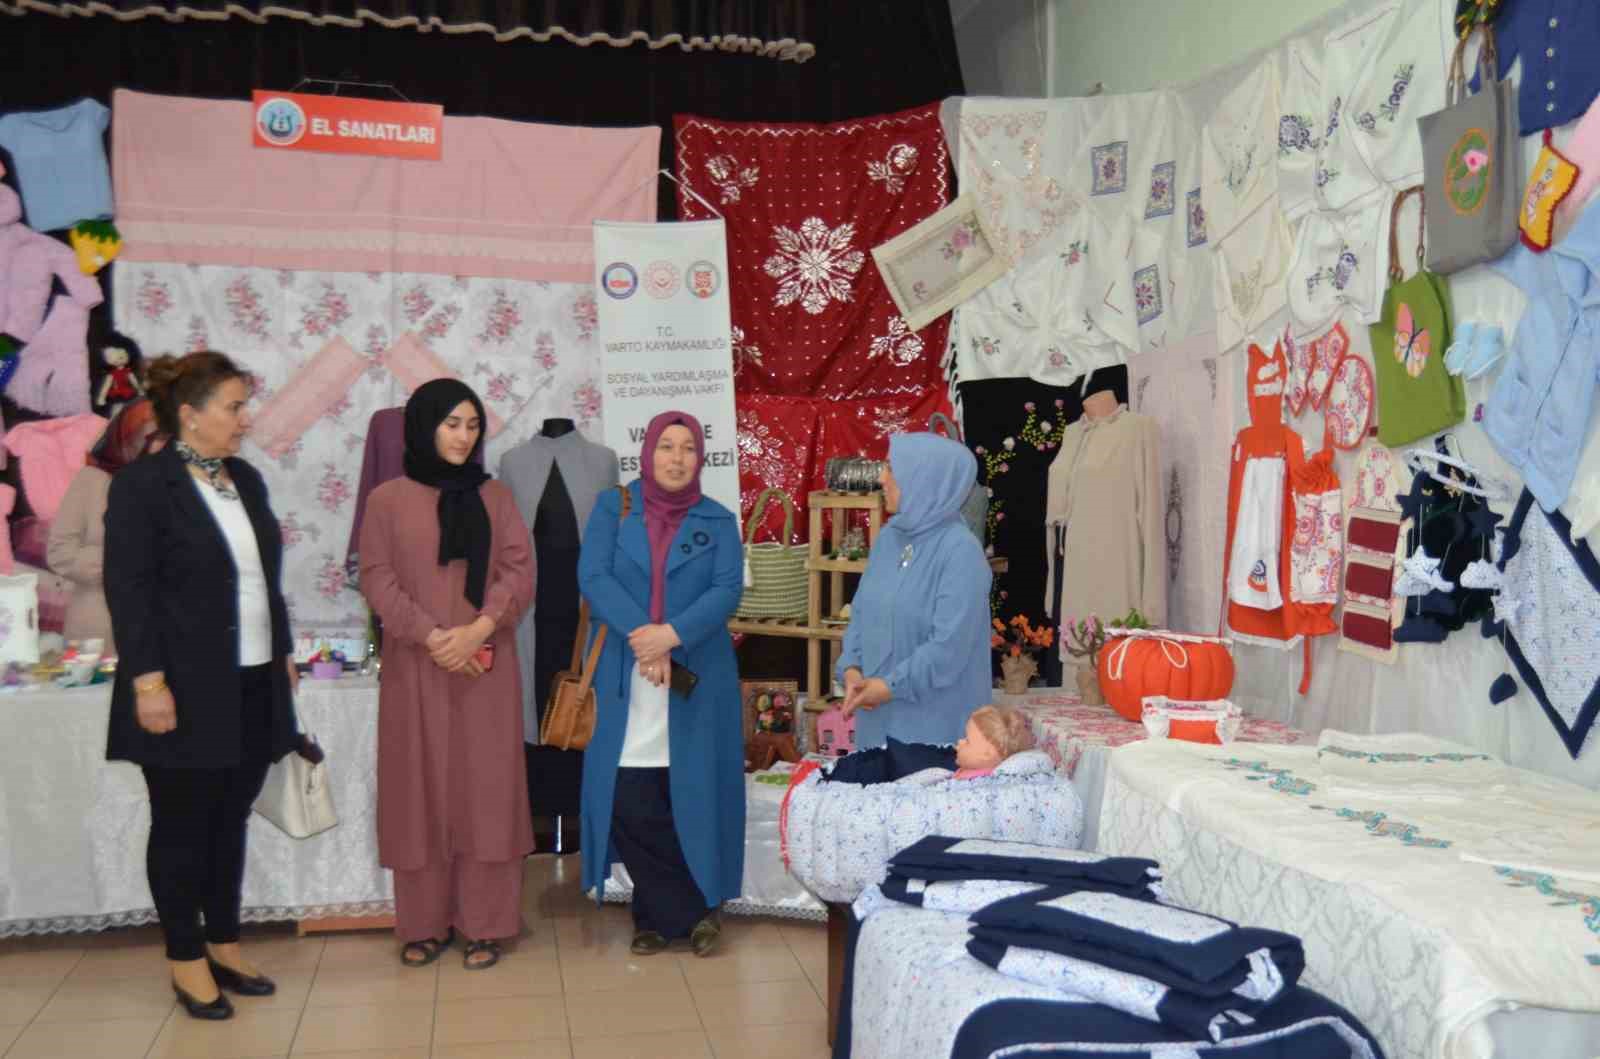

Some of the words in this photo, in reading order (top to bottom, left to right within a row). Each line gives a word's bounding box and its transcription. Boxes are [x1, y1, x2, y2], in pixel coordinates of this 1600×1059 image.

[311, 117, 334, 136] EL
[338, 119, 436, 144] SANATLARI
[606, 342, 642, 353] VARTO
[607, 371, 649, 384] SOSYAL
[652, 369, 728, 383] YARDIMLAŞMA
[613, 387, 627, 398] VE
[630, 385, 693, 398] DAYANIŞMA
[702, 448, 735, 467] KEZİ
